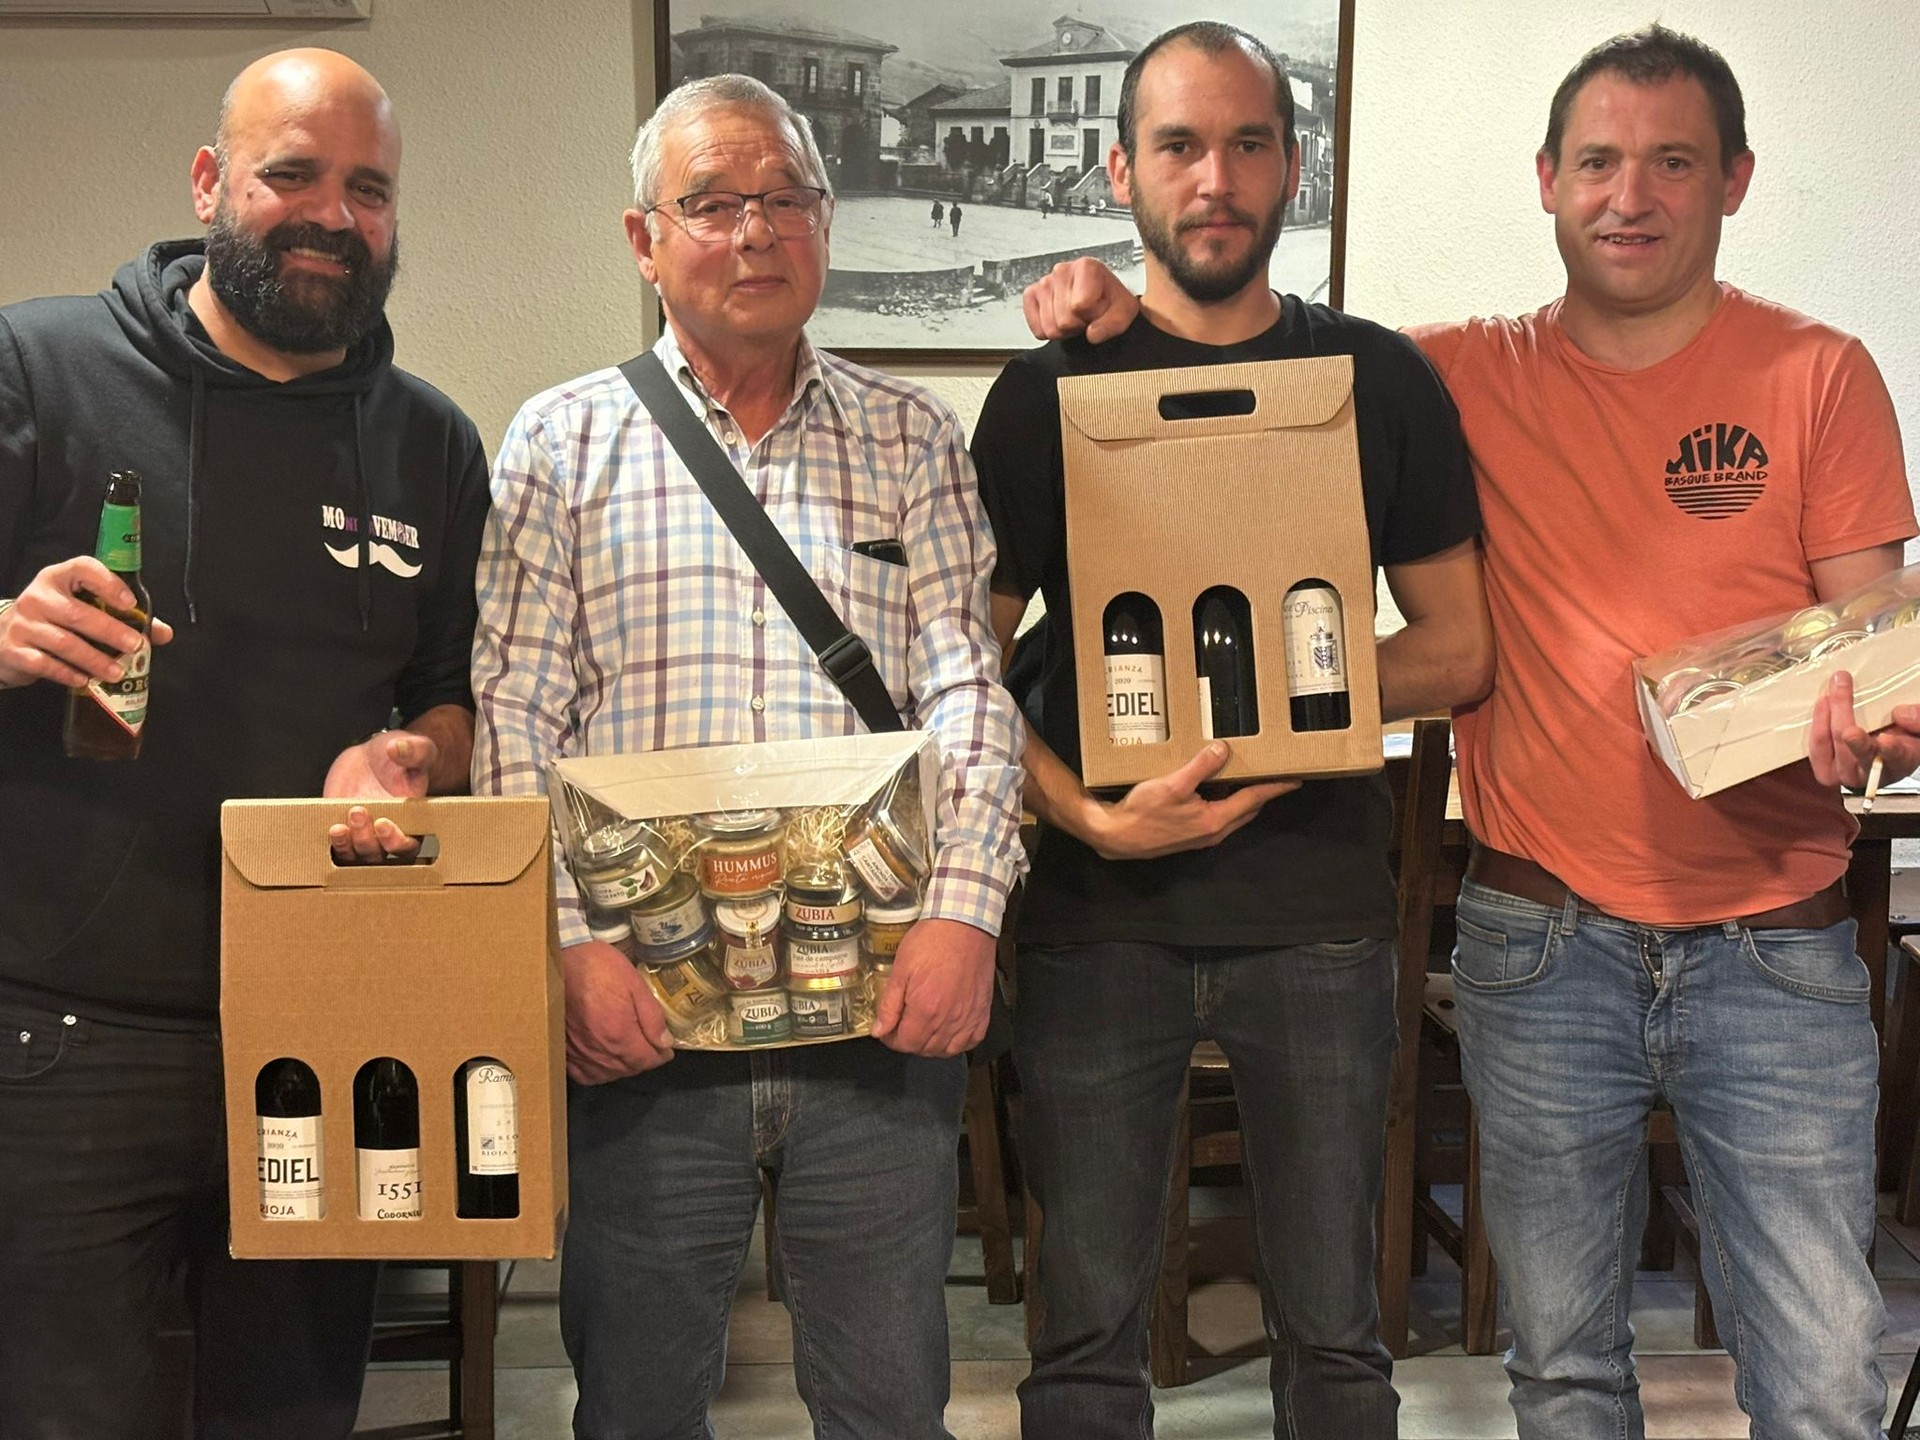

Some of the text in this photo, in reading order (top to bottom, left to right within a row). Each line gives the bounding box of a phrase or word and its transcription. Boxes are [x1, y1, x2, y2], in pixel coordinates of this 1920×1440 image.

[1664, 471, 1768, 486] BASQUE BRAND
[1105, 665, 1142, 675] RIANZA
[1106, 692, 1160, 717] EDIEL
[713, 852, 777, 873] HUMMUS
[795, 906, 835, 921] ZUBIA
[796, 944, 829, 955] ZUBIA
[743, 1005, 780, 1020] ZUBIA
[792, 1000, 816, 1012] UBIA
[257, 1156, 320, 1184] EDIEL
[377, 1180, 422, 1201] 1551
